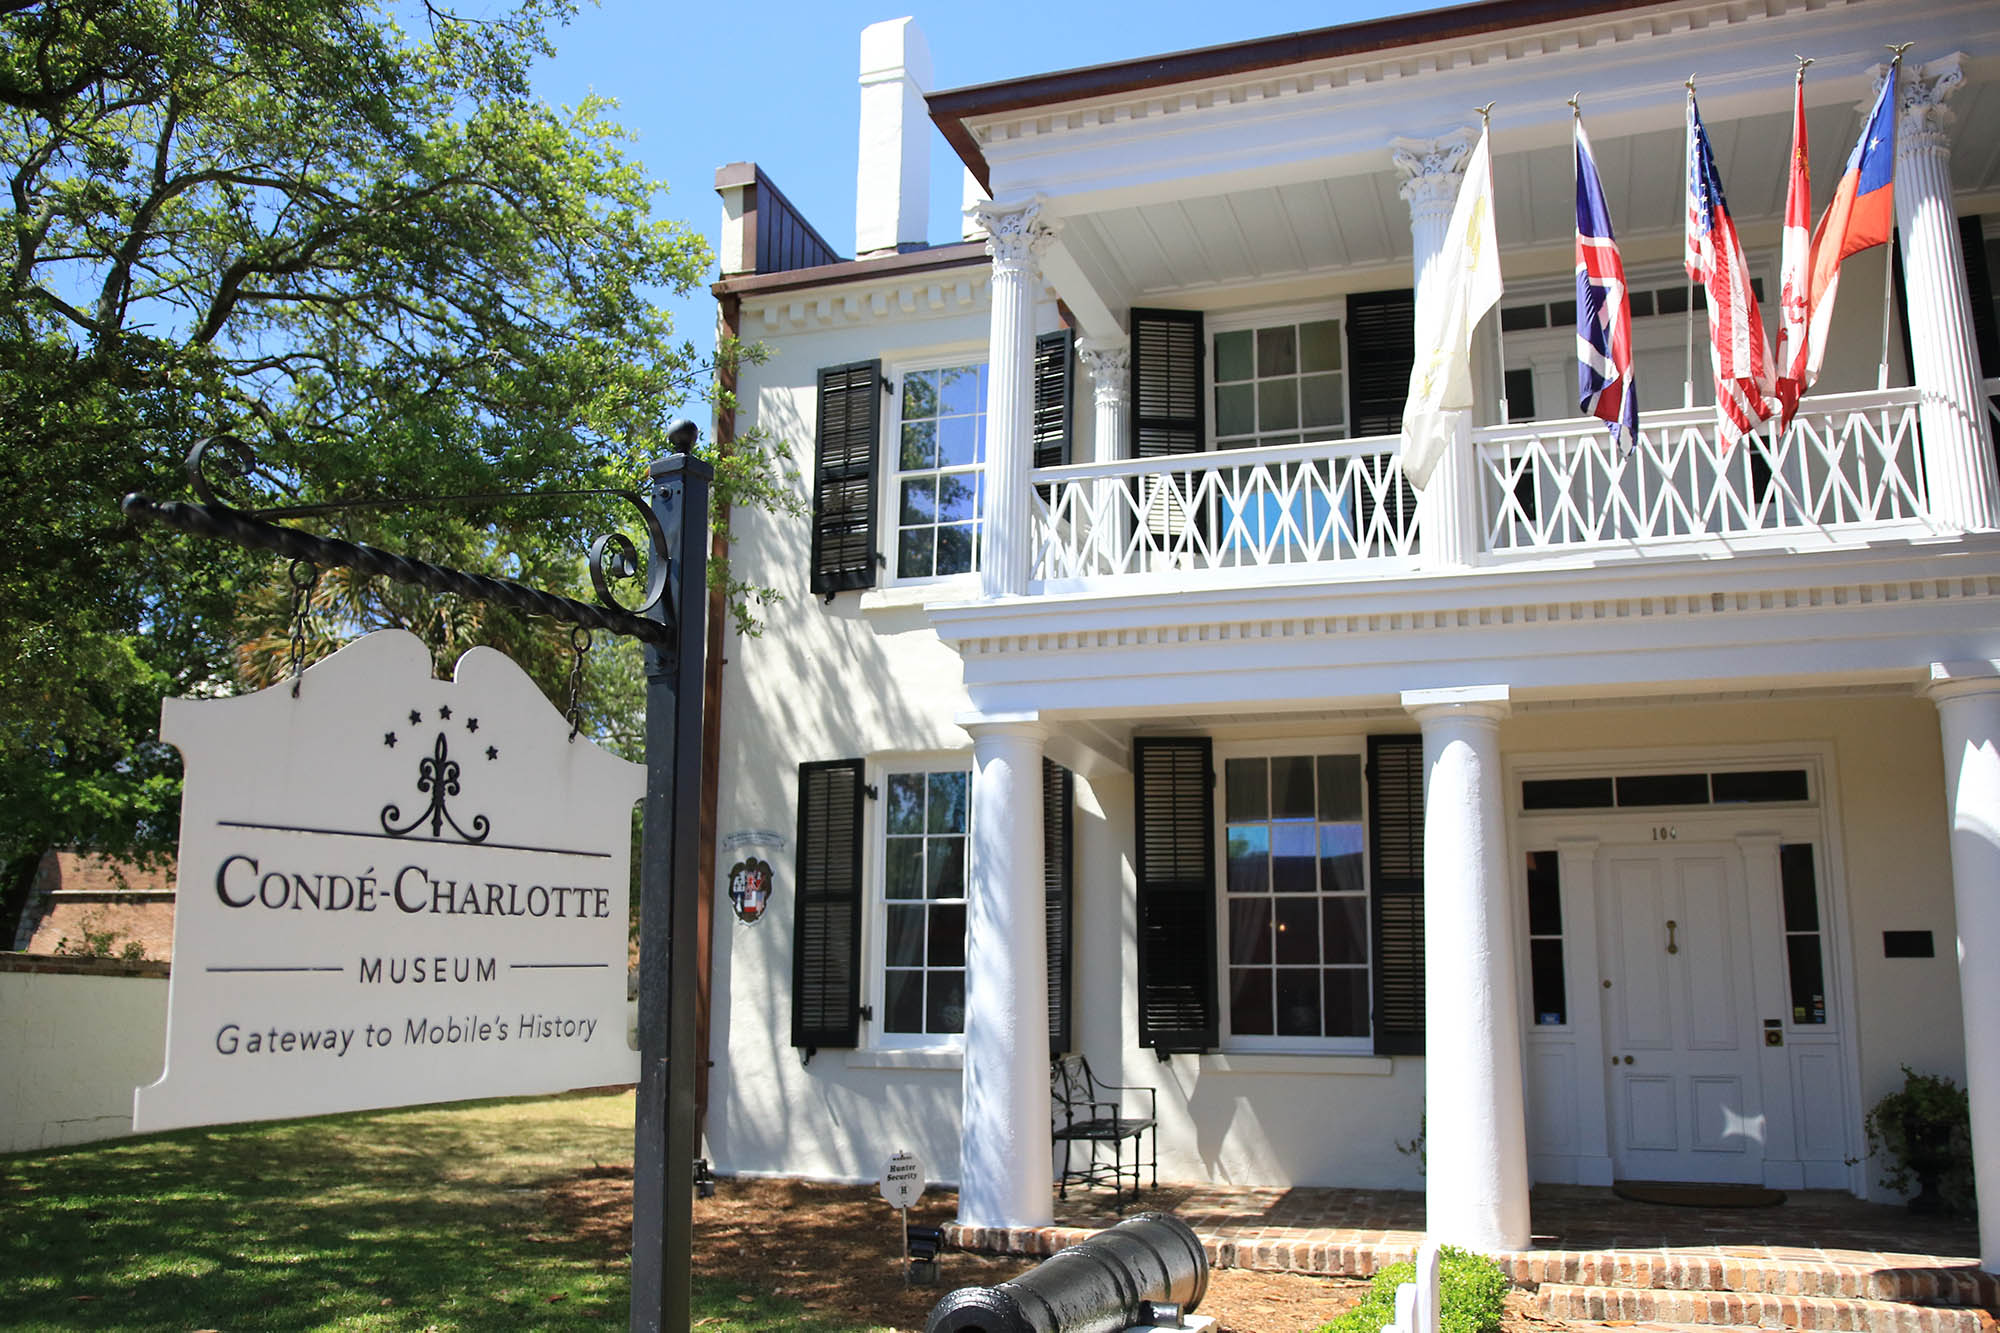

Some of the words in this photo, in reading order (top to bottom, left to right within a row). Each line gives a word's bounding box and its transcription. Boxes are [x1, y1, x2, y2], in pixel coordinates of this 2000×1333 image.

[359, 957, 497, 984] MUSEUM
[215, 1022, 353, 1057] Gateway
[366, 1023, 392, 1048] to
[405, 1015, 509, 1046] Mobile's
[518, 1012, 598, 1042] History
[887, 1173, 918, 1182] Security
[889, 1164, 916, 1173] Hunter
